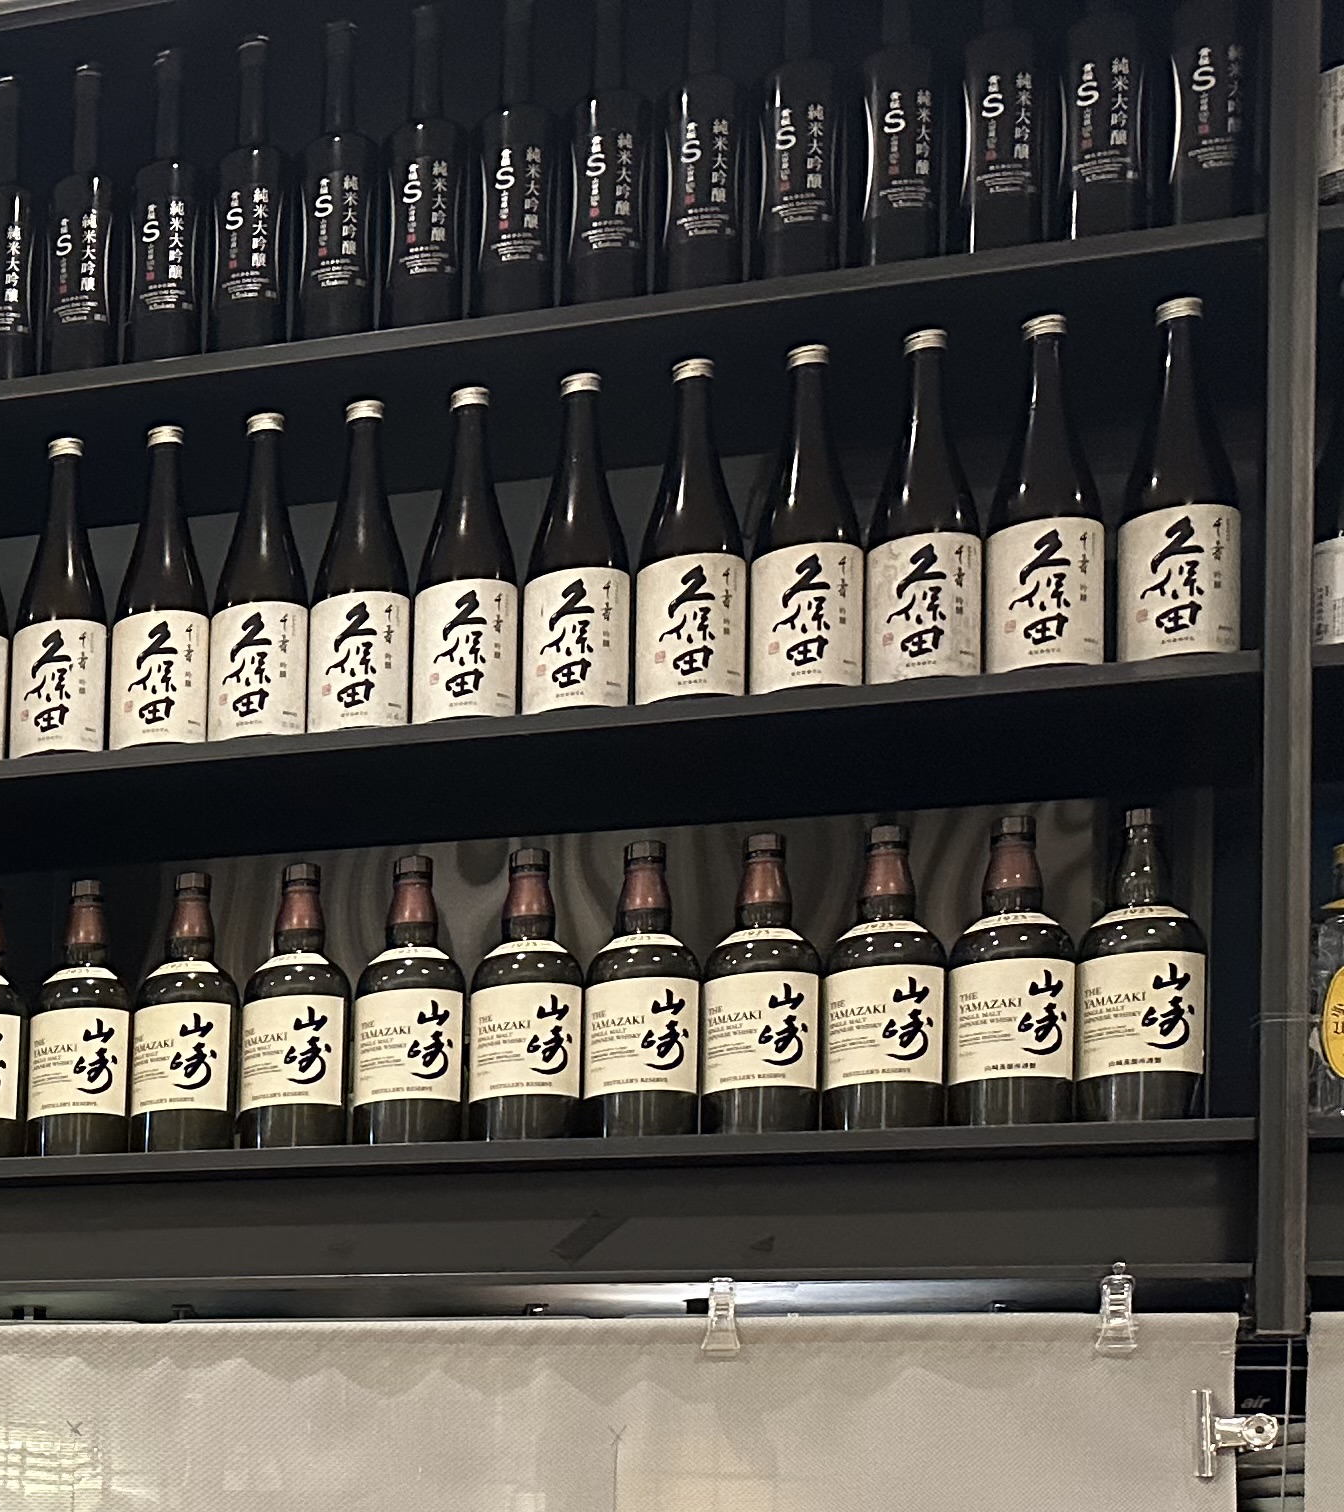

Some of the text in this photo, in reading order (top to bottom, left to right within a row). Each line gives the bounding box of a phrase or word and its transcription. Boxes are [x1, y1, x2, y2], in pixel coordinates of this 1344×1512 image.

[1077, 82, 1099, 106] S
[1110, 58, 1129, 145] 純米大吟醸
[1192, 66, 1215, 91] S
[681, 140, 701, 163] S
[711, 119, 728, 202] 純米大吟醸
[884, 110, 905, 133] S
[916, 90, 930, 174] 純米大吟醸
[495, 167, 515, 189] S
[524, 147, 540, 228] 純米大吟醸
[586, 154, 606, 177] S
[615, 134, 632, 215] 純米大吟醸
[142, 221, 159, 242] S
[169, 200, 184, 279] 純米大吟醸
[226, 208, 243, 230] S
[252, 188, 268, 267] 純米大吟醸
[315, 195, 333, 217] S
[342, 176, 358, 254] 純米大吟醸
[5, 226, 21, 302] 純米大吟醸
[772, 554, 831, 666] 久保田
[886, 543, 947, 658] 久保田
[1009, 529, 1071, 645] 久保田
[1140, 516, 1204, 634] 久保田
[326, 601, 377, 708] 久保田
[434, 590, 487, 697] 久保田
[540, 579, 594, 688] 久保田
[659, 565, 715, 676] 久保田
[24, 629, 73, 732] 久保田
[128, 621, 178, 724] 久保田
[222, 612, 272, 717] 久保田
[360, 1025, 411, 1039] YAMAZAKI
[477, 1020, 531, 1035] YAMAZAKI
[591, 1015, 645, 1029] YAMAZAKI
[592, 1010, 606, 1019] THE
[641, 989, 689, 1070] 山崎
[708, 1010, 762, 1026] YAMAZAKI
[758, 983, 808, 1066] 山崎
[829, 1004, 886, 1022] YAMAZAKI
[882, 977, 933, 1060] 山崎
[959, 991, 978, 1001] THE
[959, 998, 1022, 1013] YAMAZAKI
[1018, 970, 1066, 1055] 山崎
[1084, 987, 1102, 998] THE
[1084, 991, 1146, 1009] YAMAZAKI
[1142, 963, 1195, 1049] 山崎
[74, 1018, 117, 1094] 山崎
[170, 1013, 217, 1090] 山崎
[284, 1006, 331, 1084] 山崎
[408, 1000, 453, 1079] 山崎
[527, 994, 572, 1075] 山崎
